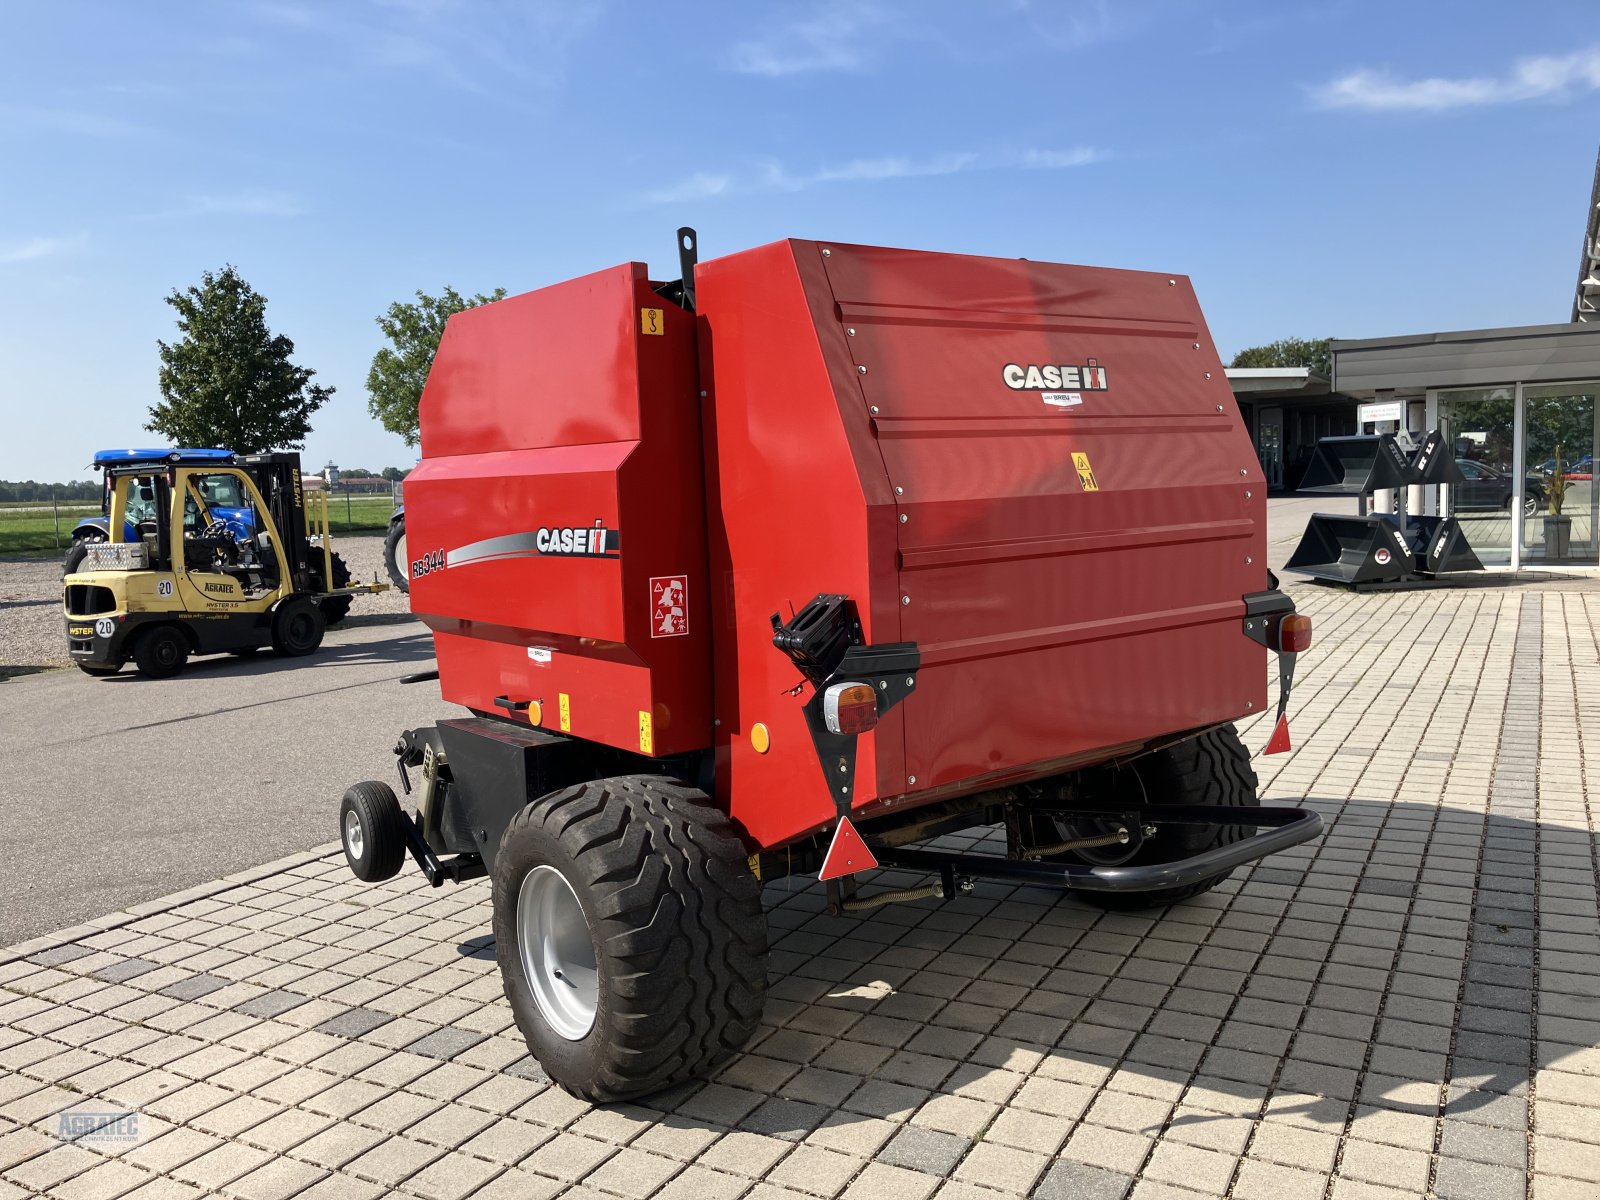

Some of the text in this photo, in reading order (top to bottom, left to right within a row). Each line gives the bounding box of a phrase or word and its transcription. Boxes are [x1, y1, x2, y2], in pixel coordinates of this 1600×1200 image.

[1003, 363, 1080, 390] CASE
[292, 467, 302, 508] HYSTER
[536, 527, 587, 555] CASE
[411, 548, 445, 579] RB344
[159, 581, 172, 595] 20
[204, 582, 234, 593] AGRATEC
[98, 621, 112, 635] 20
